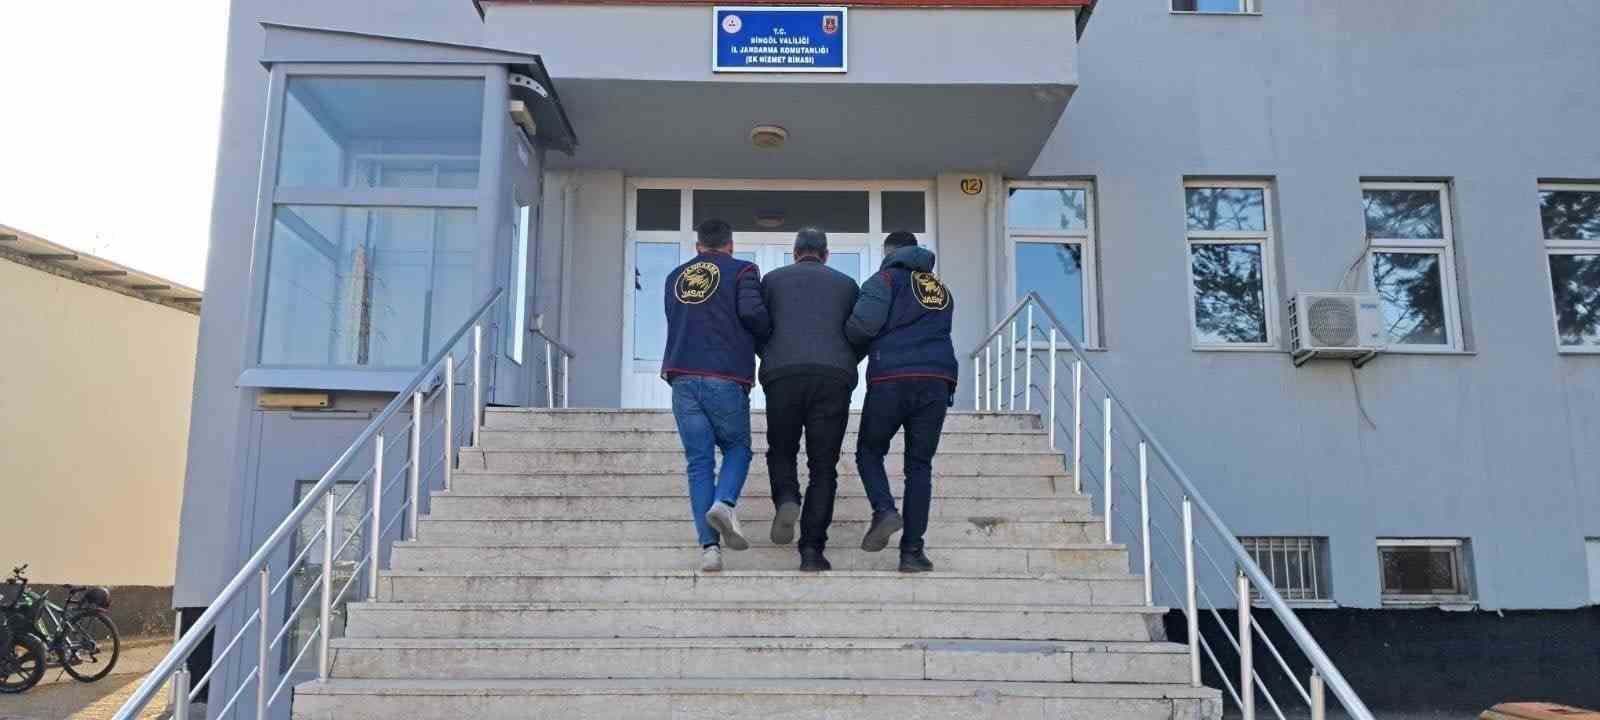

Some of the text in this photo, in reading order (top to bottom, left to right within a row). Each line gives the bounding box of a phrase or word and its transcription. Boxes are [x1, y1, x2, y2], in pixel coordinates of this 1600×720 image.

[750, 36, 810, 44] BİNGÖL VALİLİĞİ
[740, 46, 779, 54] JANDARMA
[780, 45, 829, 54] KOMUTANLIĞI
[759, 56, 786, 64] HİZMET
[787, 56, 815, 64] BİNASI)
